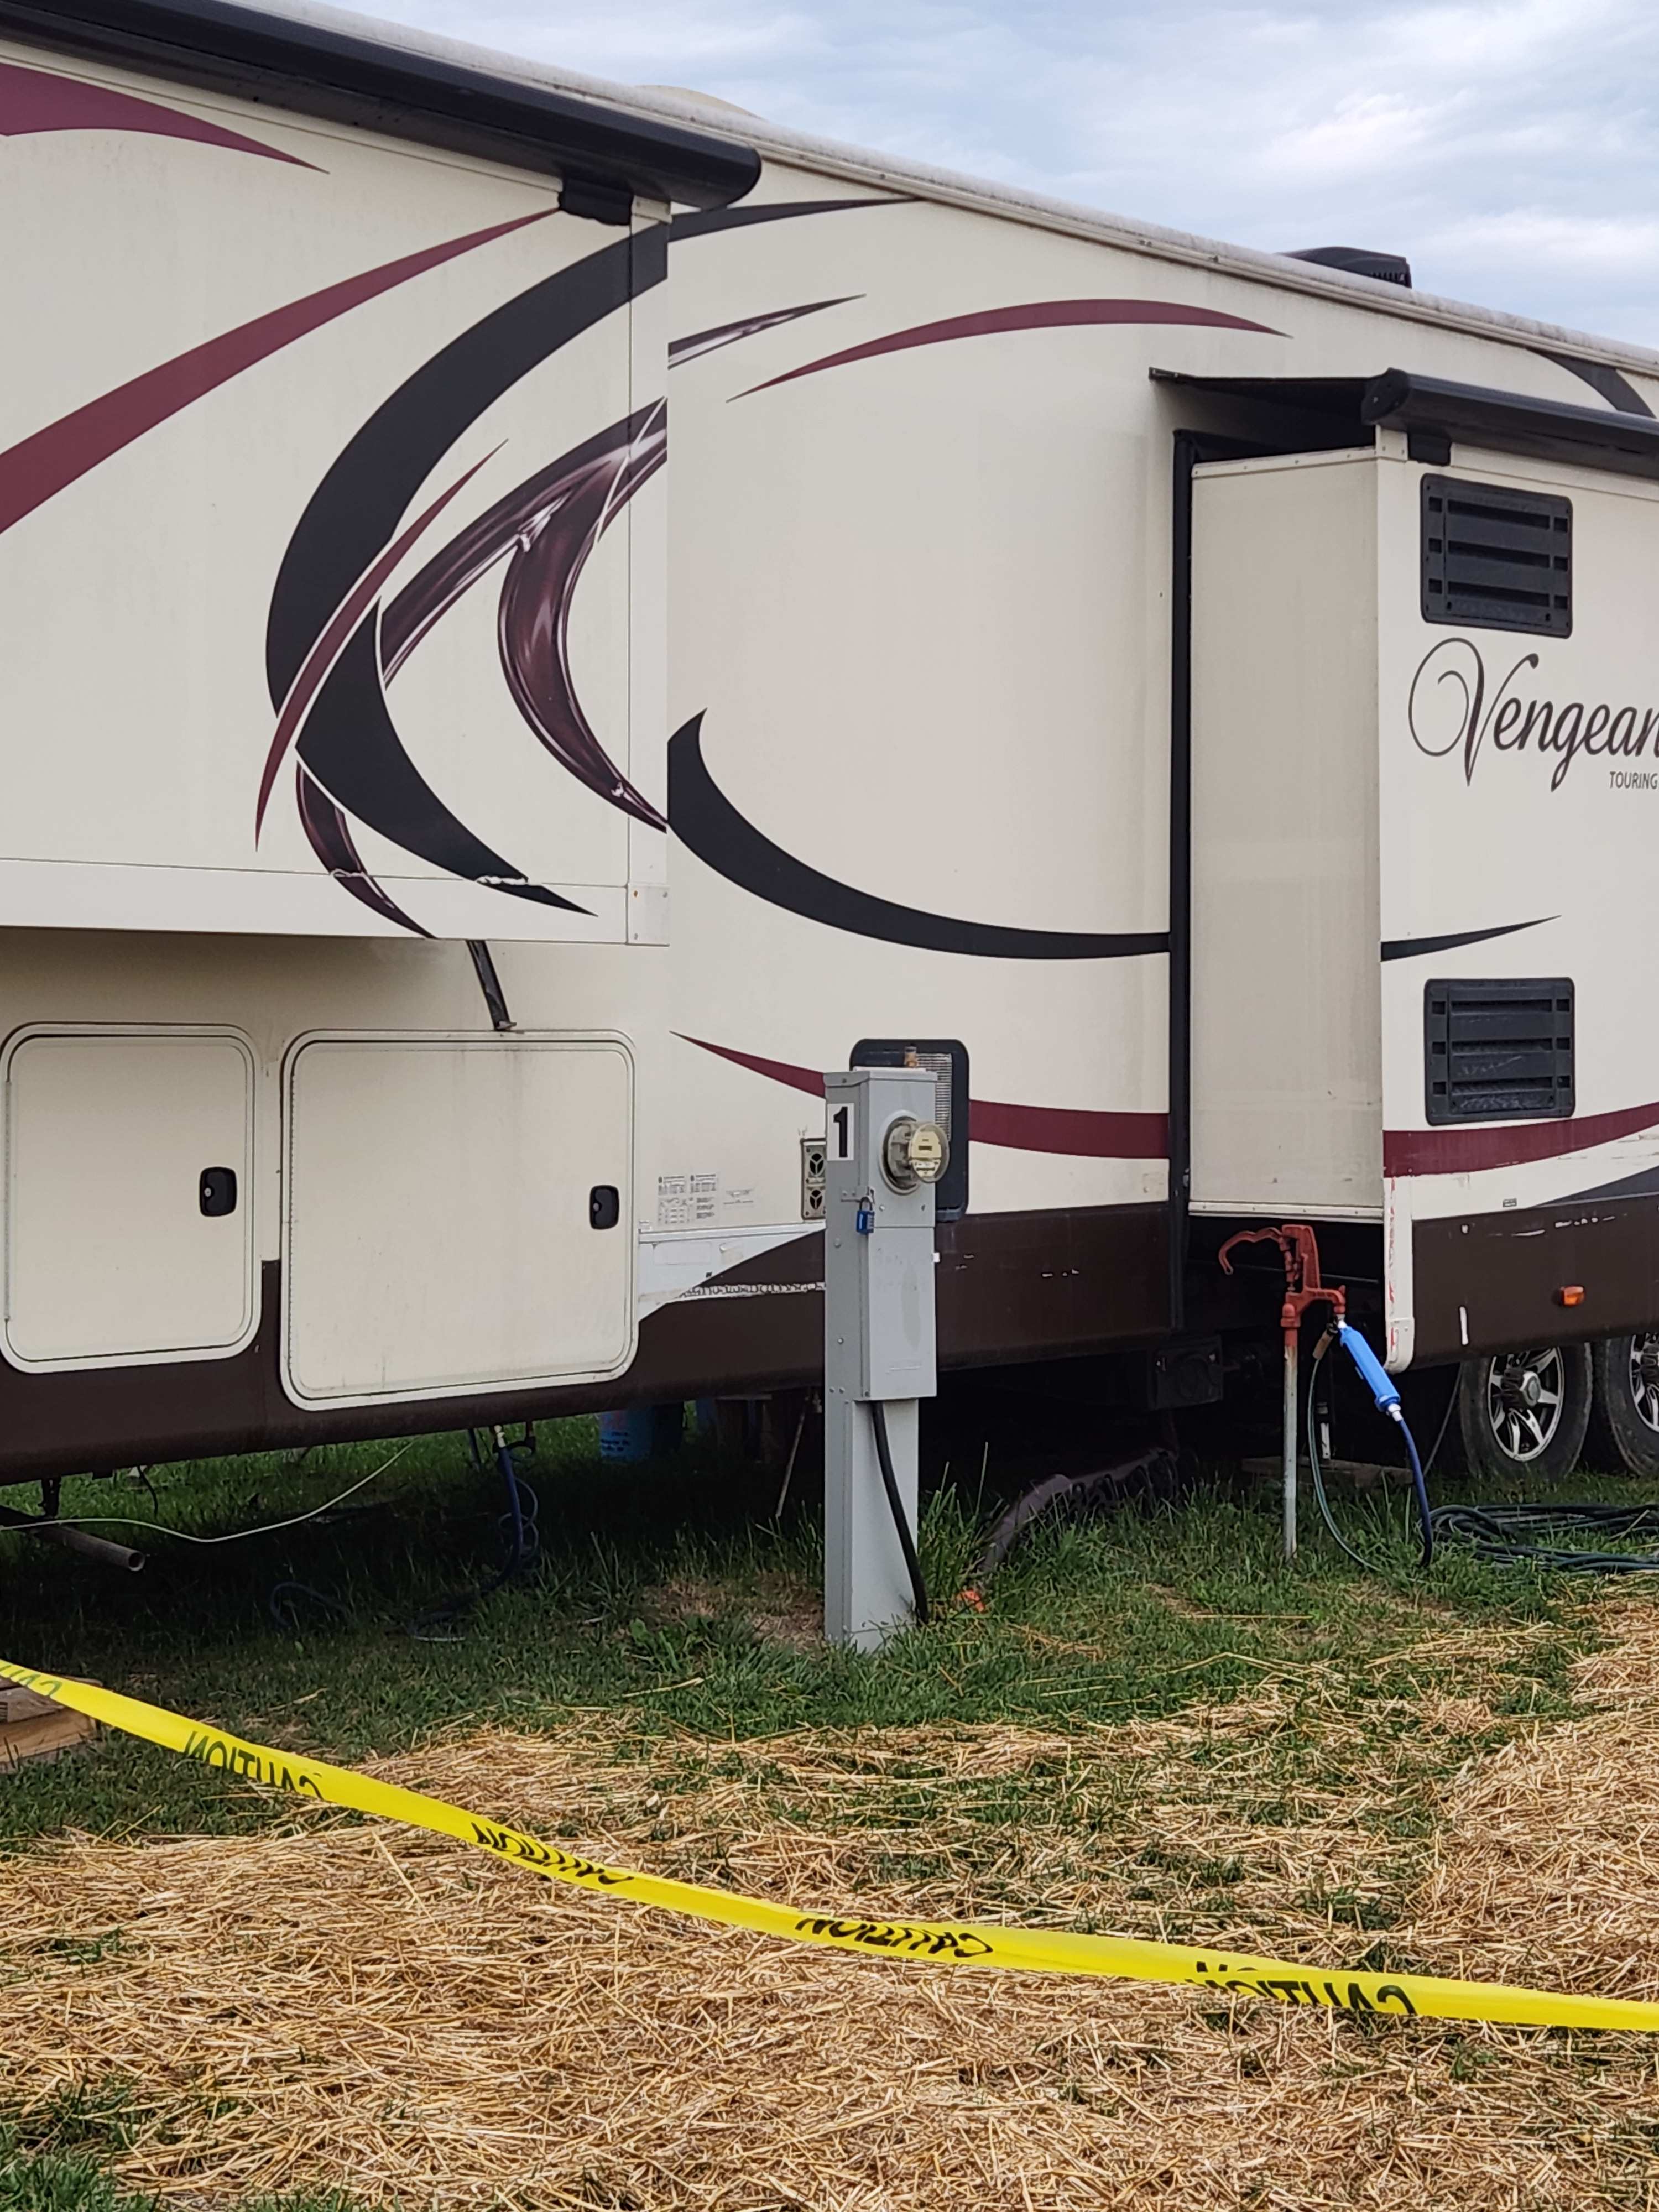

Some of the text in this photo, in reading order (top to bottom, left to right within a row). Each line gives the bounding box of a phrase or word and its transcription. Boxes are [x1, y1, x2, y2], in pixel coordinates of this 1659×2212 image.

[1609, 771, 1658, 790] TOURING
[833, 1106, 848, 1158] 1
[794, 1918, 993, 1958] CAUTION
